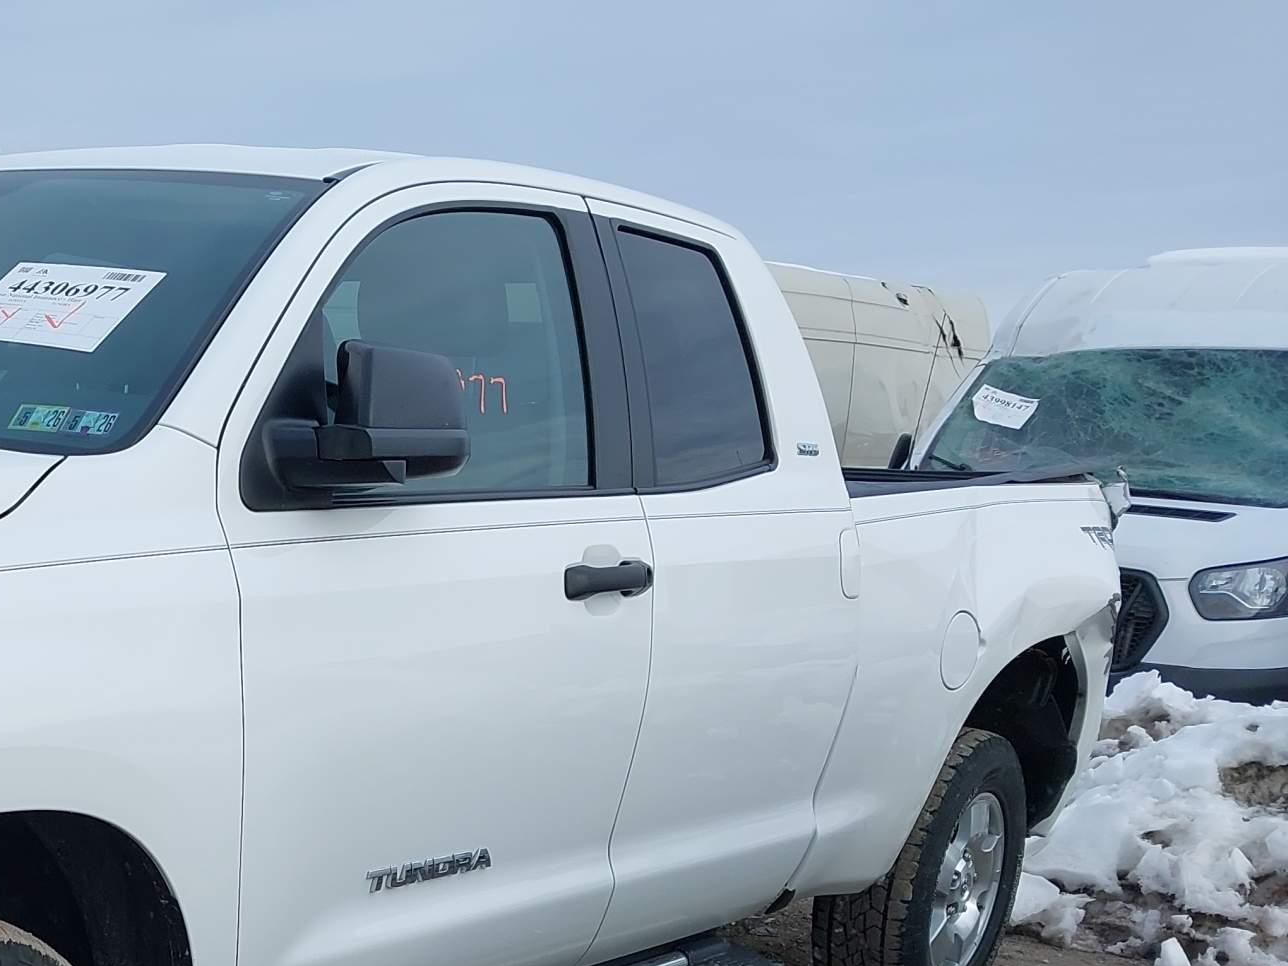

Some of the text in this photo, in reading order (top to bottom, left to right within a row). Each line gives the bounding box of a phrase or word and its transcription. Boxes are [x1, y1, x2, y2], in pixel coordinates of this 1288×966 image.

[8, 279, 131, 302] 44306977
[19, 411, 32, 427] 5
[69, 415, 81, 431] 5
[365, 847, 493, 894] TUNDRA
